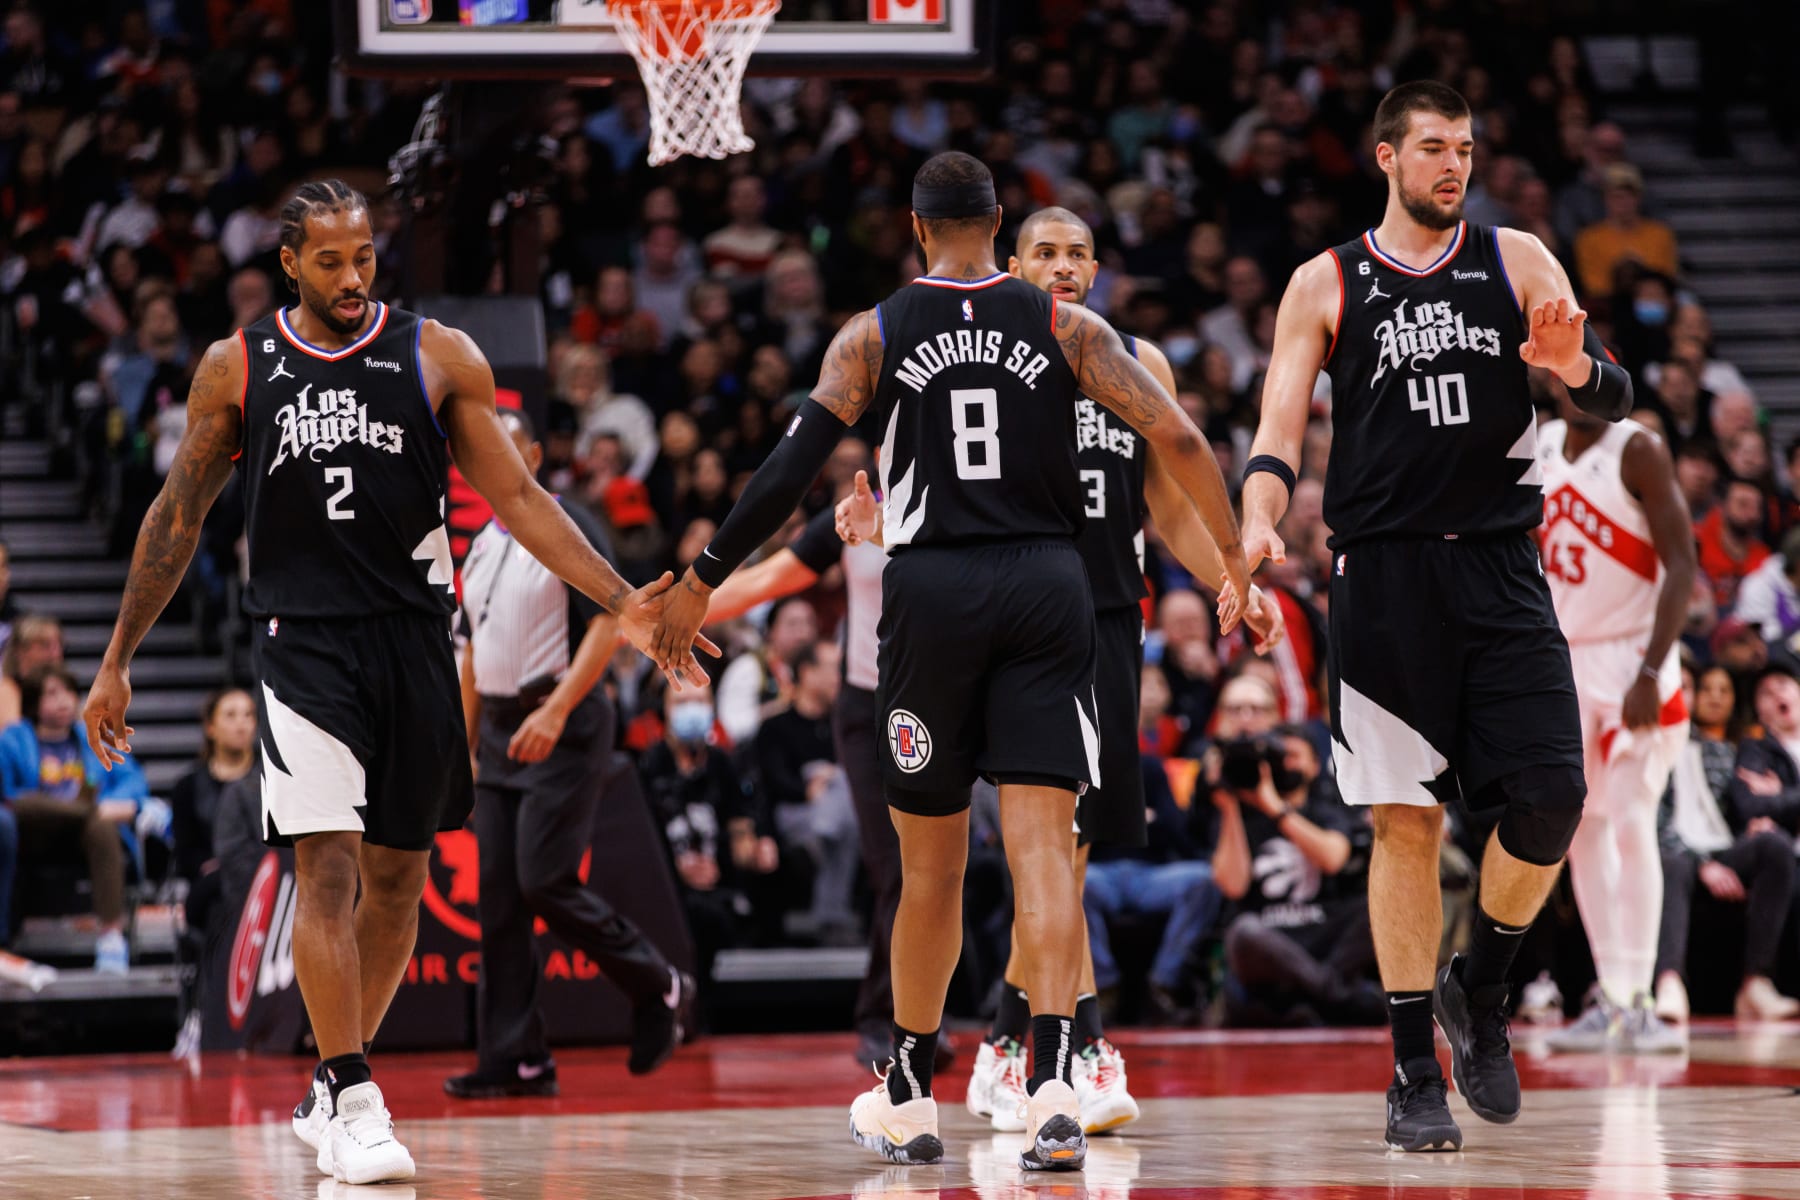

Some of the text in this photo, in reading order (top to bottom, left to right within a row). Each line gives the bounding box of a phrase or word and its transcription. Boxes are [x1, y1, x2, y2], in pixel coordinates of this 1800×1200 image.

[1358, 261, 1371, 275] 6
[1393, 298, 1455, 334] Los
[263, 339, 276, 353] 6
[363, 357, 402, 373] honey
[894, 329, 1050, 393] MORRIS SR.
[1371, 312, 1501, 390] Angeles
[296, 383, 360, 421] Los
[1407, 372, 1470, 427] 40
[268, 403, 404, 476] Angeles
[950, 388, 1001, 480] 8
[1076, 412, 1136, 460] eles
[324, 467, 355, 520] 2
[1079, 469, 1106, 518] 3
[400, 953, 448, 985] IR
